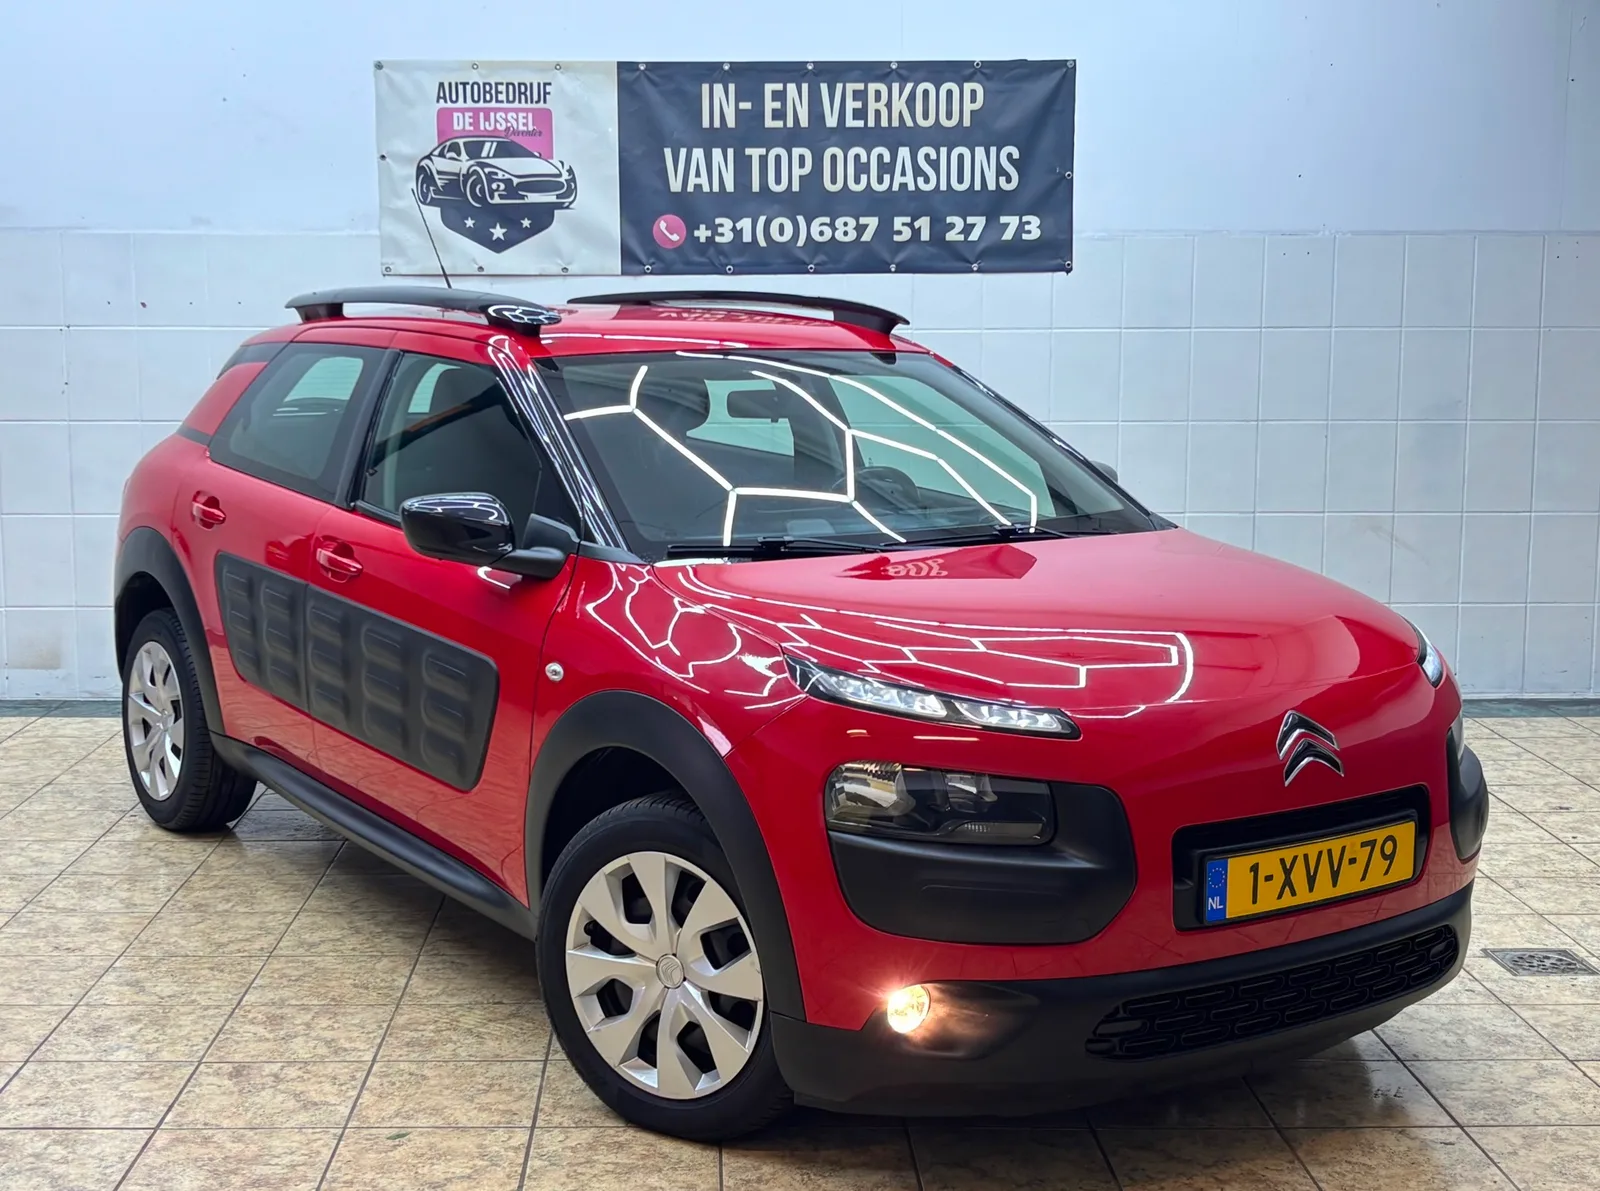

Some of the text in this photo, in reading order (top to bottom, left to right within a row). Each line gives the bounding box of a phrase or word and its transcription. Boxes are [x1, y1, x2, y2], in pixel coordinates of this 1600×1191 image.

[436, 81, 552, 104] AUTOBEDRIJF
[701, 82, 985, 128] IN- EN VERKOOP
[453, 112, 536, 130] DE IJSSEL
[664, 146, 1020, 193] VAN TOP OCCASIONS
[693, 215, 1042, 247] +31(0)687 51 27 73
[1249, 835, 1398, 905] 1-XVV-79
[1207, 896, 1224, 911] NL
